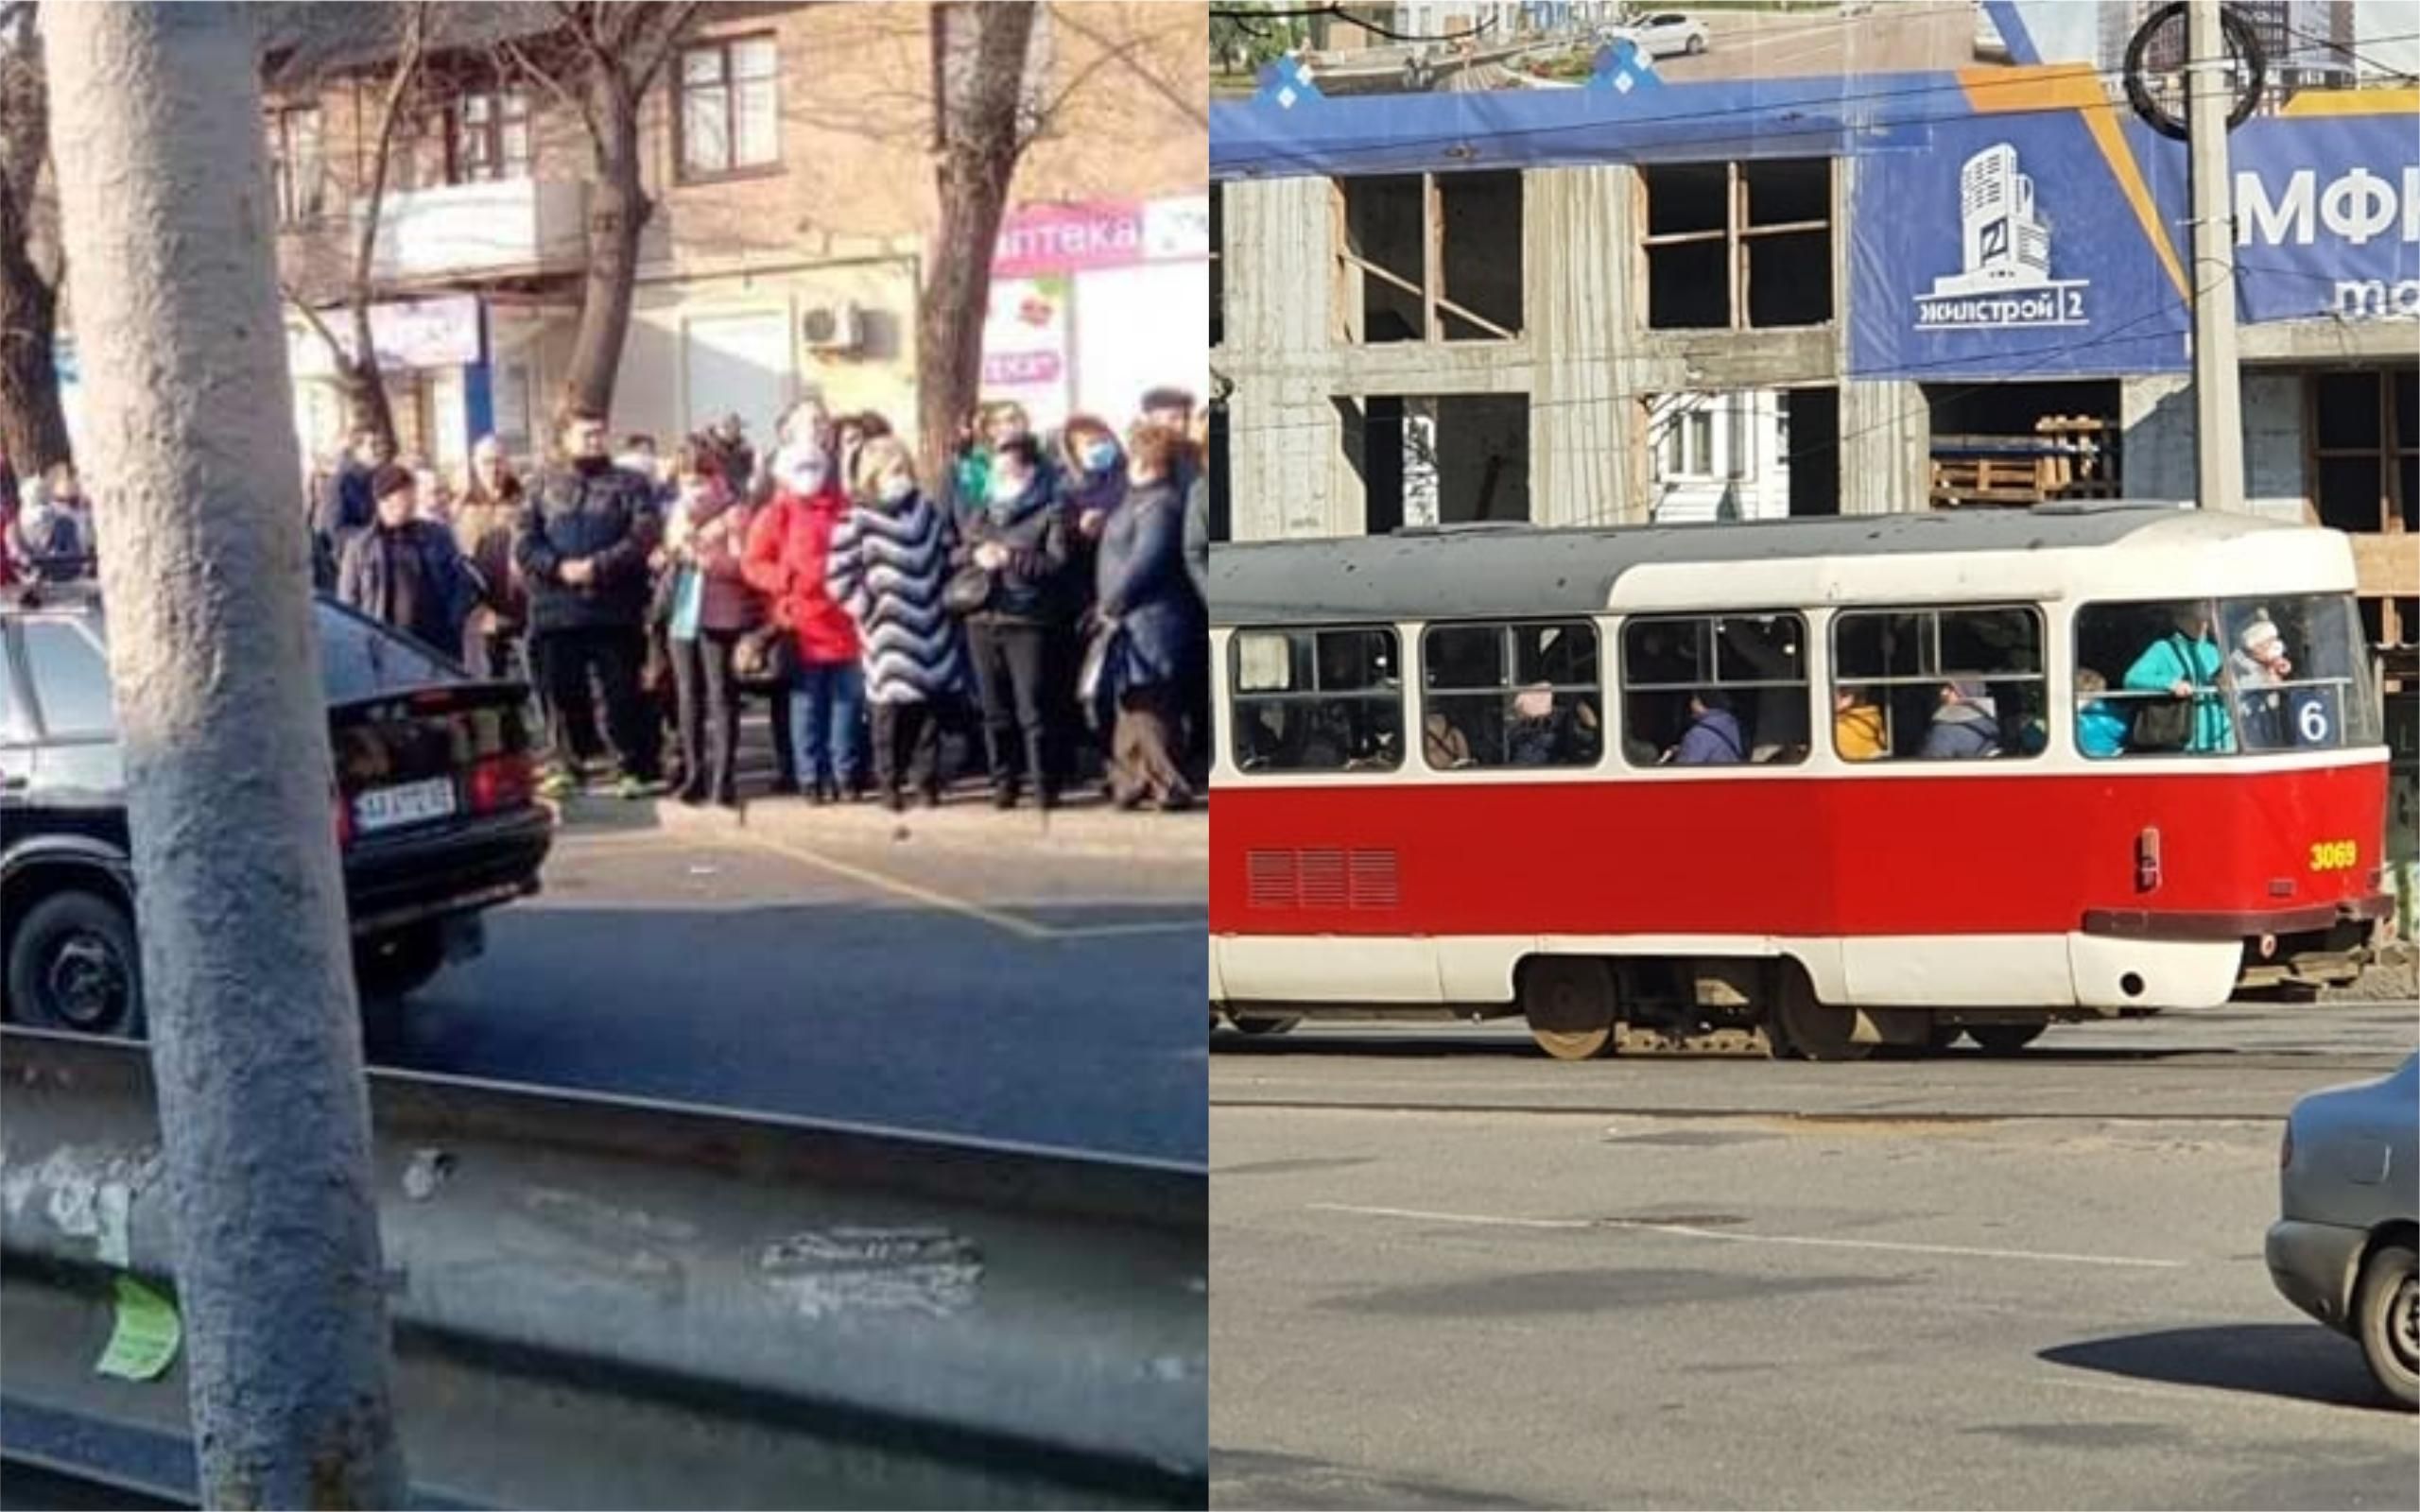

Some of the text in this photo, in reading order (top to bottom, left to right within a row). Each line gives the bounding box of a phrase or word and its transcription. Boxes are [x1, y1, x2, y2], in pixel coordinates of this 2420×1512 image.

[2067, 291, 2084, 317] 2
[2299, 701, 2328, 741] 6
[2308, 839, 2357, 871] 3069
